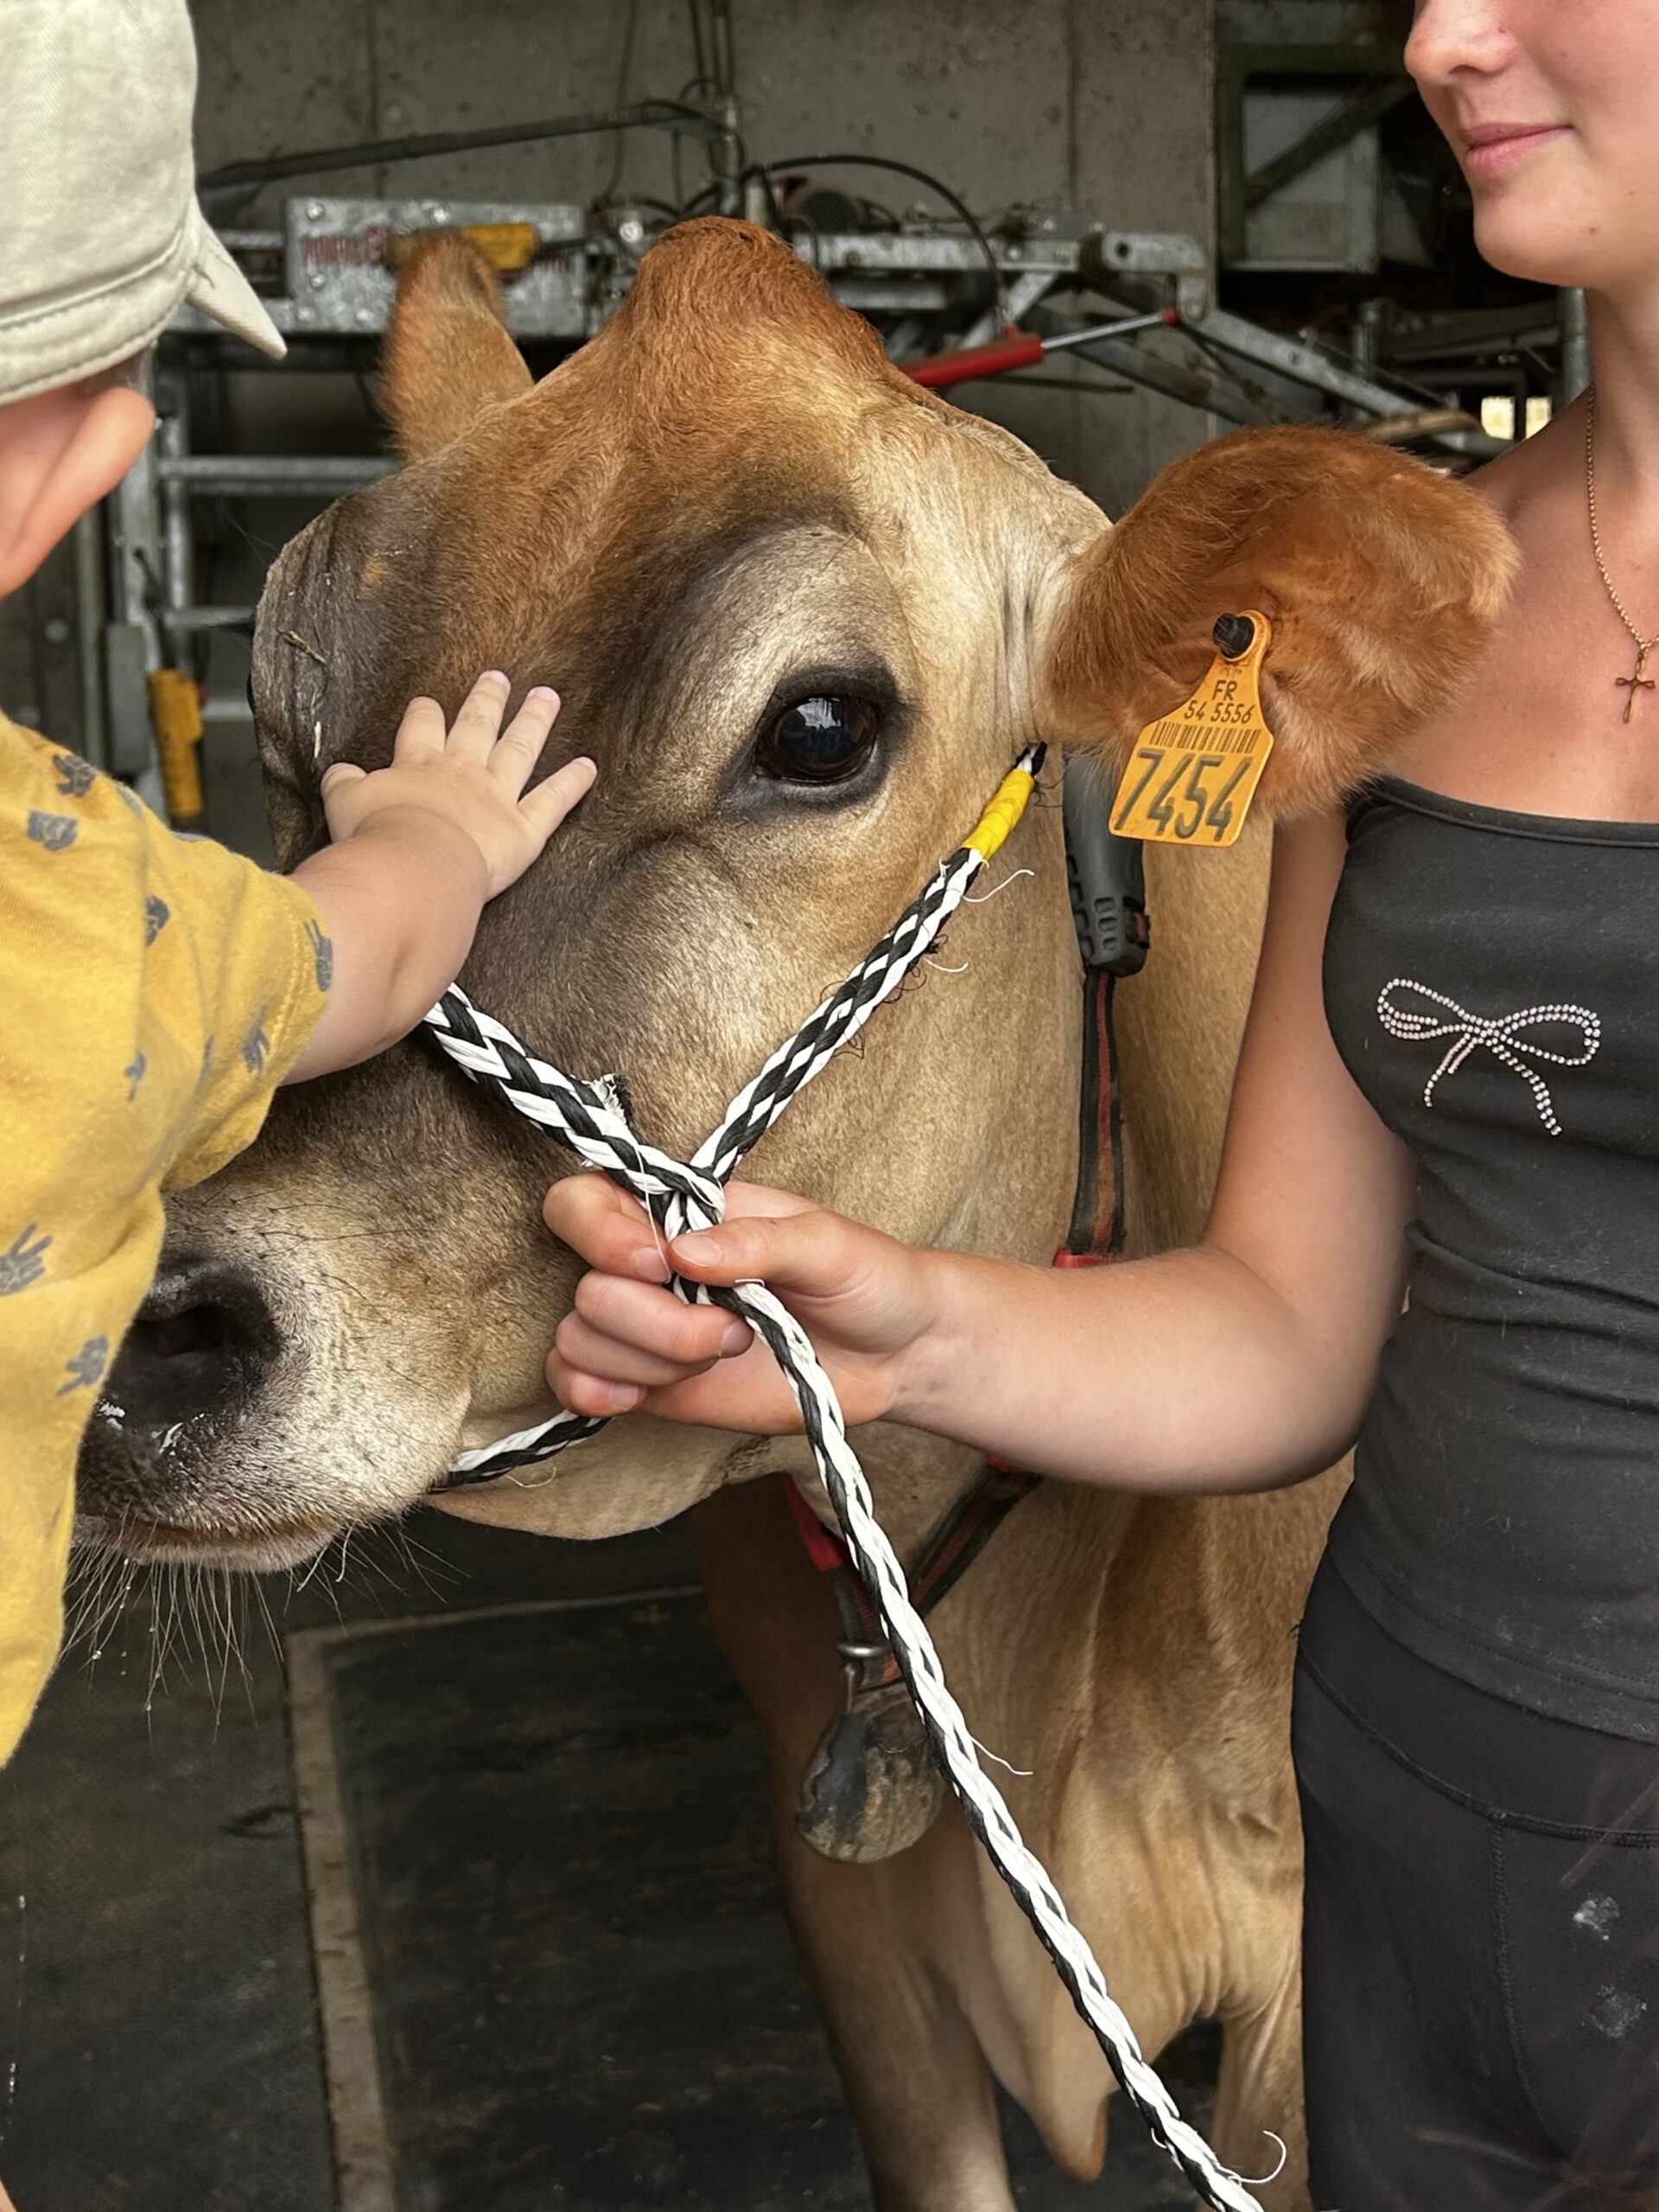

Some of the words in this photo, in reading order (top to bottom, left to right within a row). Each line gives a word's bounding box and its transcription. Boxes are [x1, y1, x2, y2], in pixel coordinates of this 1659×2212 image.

[1212, 680, 1237, 702] FR
[1184, 701, 1206, 721] 54
[1210, 702, 1255, 724] 5556
[1114, 748, 1253, 842] 7454
